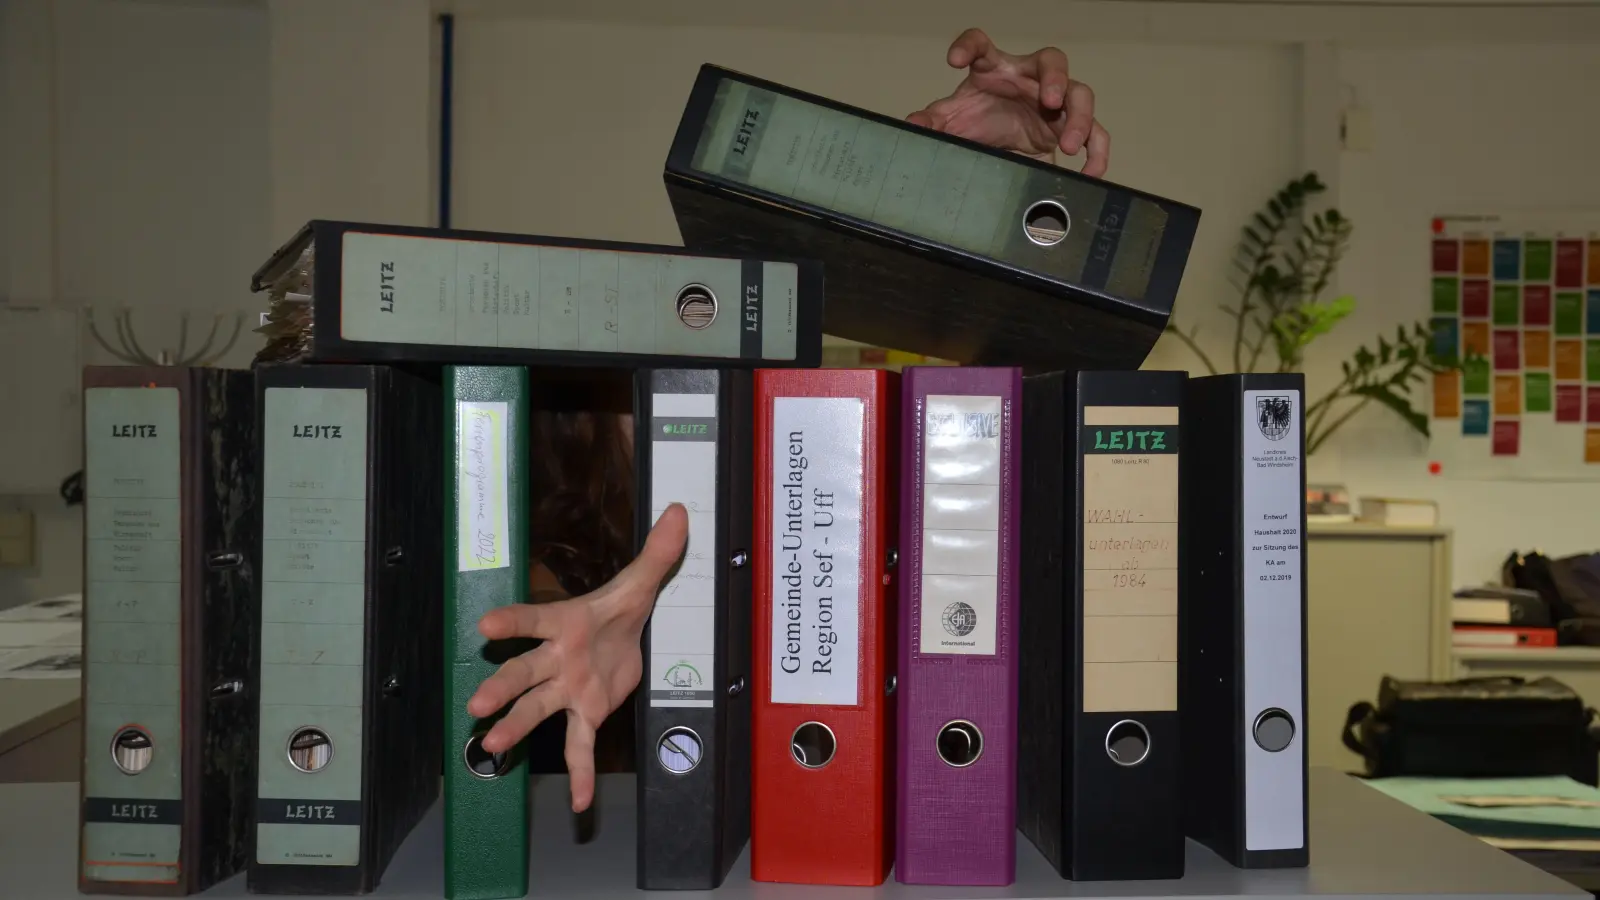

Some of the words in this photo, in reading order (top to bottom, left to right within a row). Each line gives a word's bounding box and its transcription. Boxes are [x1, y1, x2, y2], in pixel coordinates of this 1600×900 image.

[733, 108, 760, 156] LEITZ
[380, 261, 394, 314] LEITZ
[746, 285, 759, 332] LEITZ
[112, 424, 157, 438] LEITZ
[292, 424, 343, 439] LEITZ
[672, 423, 708, 435] LEITZ
[1093, 430, 1167, 451] LEITZ
[813, 488, 835, 529] Uff
[475, 528, 498, 566] 2022
[780, 430, 808, 675] Gemeinde-Unterlagen
[1088, 536, 1169, 553] unterlagen
[1263, 544, 1287, 552] Sitzung
[812, 549, 835, 588] Sef
[1113, 573, 1146, 588] 1984
[812, 596, 838, 675] Region
[111, 803, 158, 818] LEITZ
[285, 804, 336, 819] LEITZ
